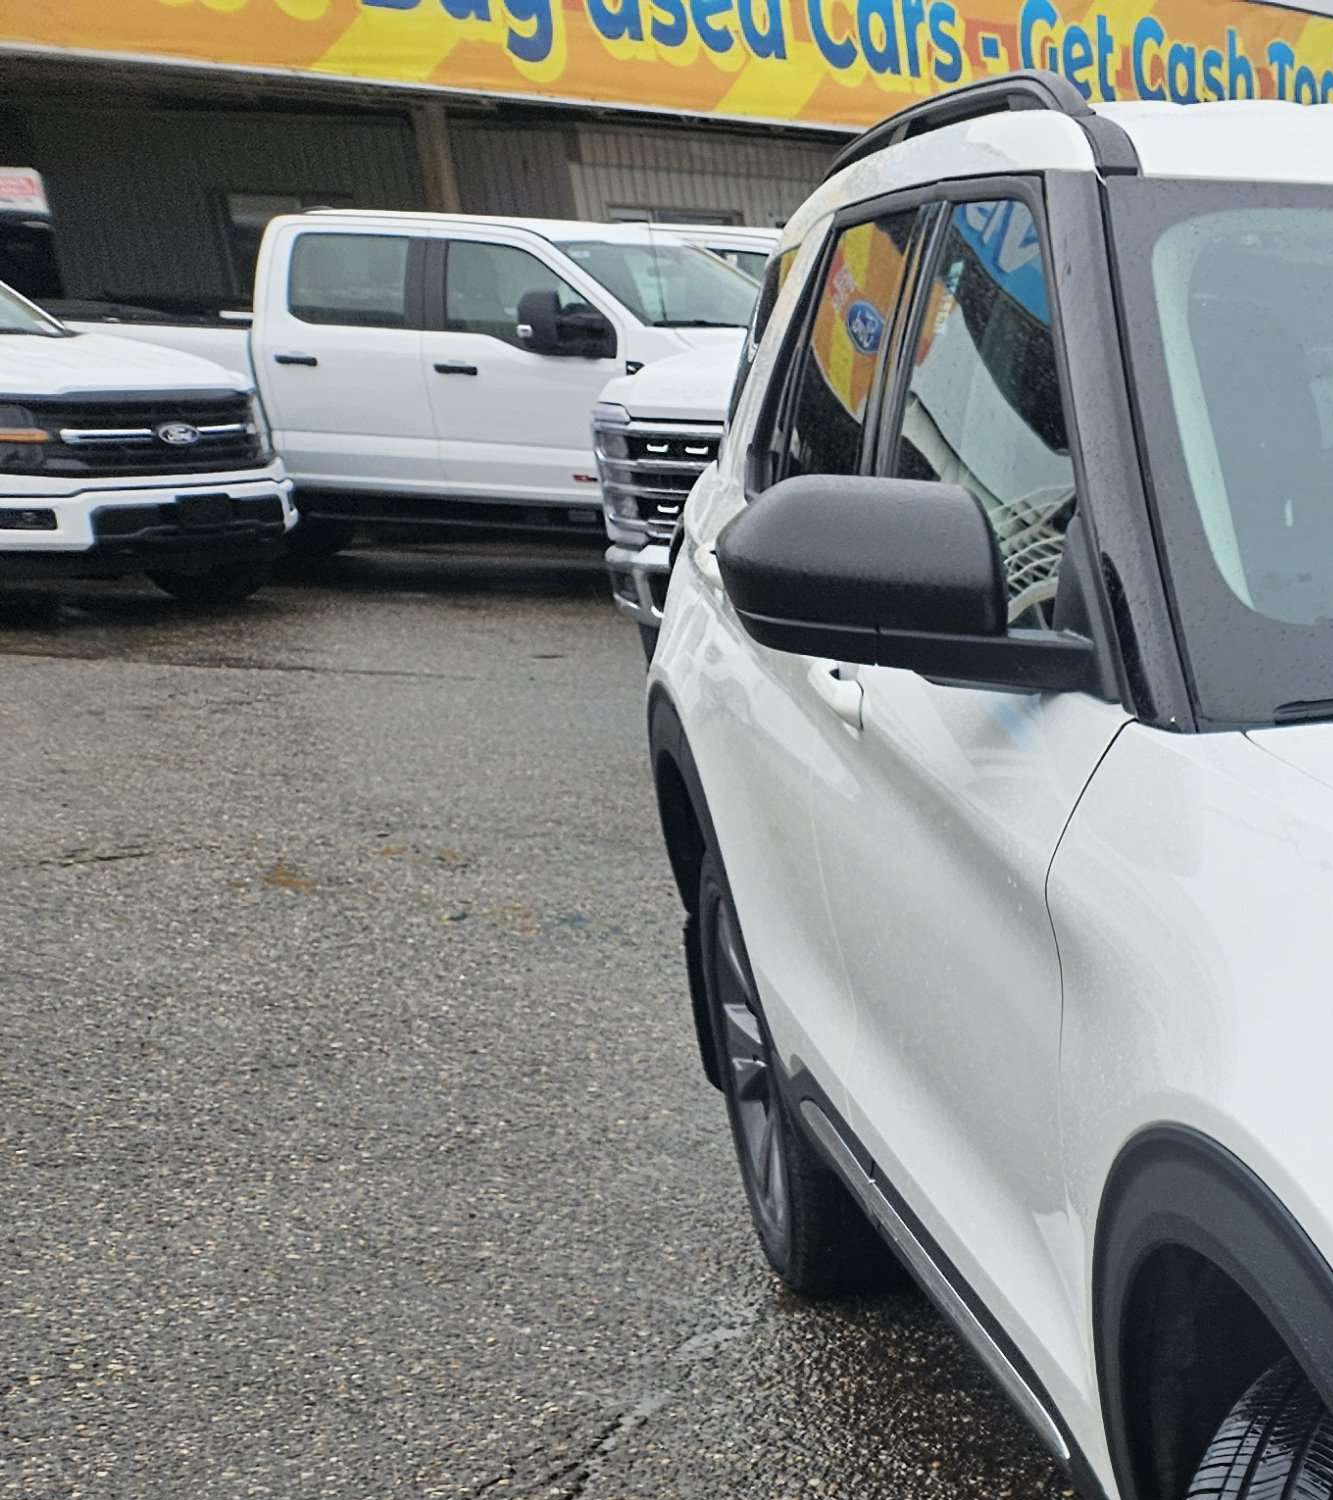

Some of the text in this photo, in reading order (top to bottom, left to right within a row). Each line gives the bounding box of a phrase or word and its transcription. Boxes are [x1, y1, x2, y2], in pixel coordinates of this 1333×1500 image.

[808, 0, 962, 83] Cars
[1020, 0, 1115, 101] Get
[1132, 17, 1254, 105] Cash
